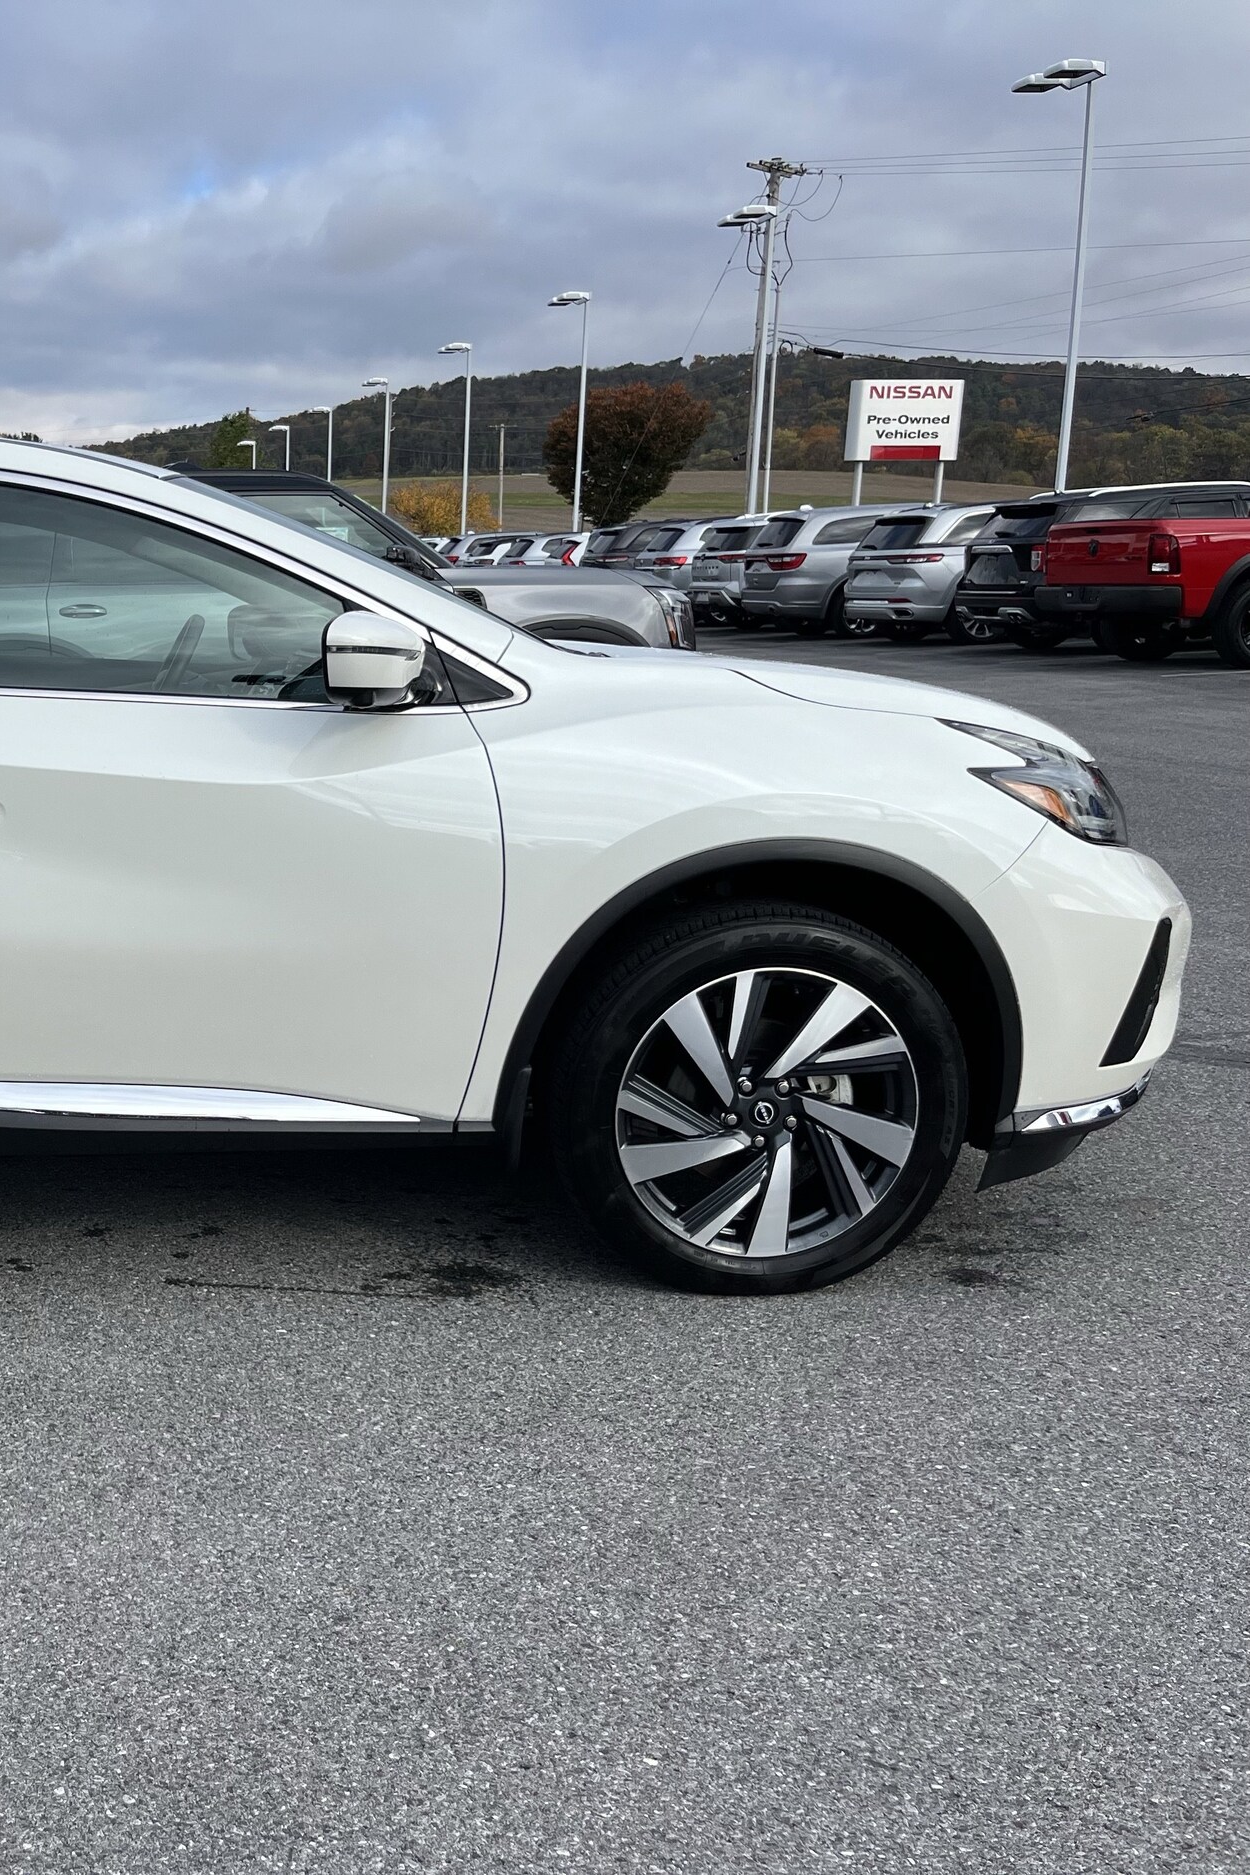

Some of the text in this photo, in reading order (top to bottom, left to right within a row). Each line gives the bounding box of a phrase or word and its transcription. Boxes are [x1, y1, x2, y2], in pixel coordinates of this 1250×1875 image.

[869, 385, 953, 399] NISSAN
[867, 414, 950, 425] Pre-Owned
[876, 429, 939, 439] Vehicles
